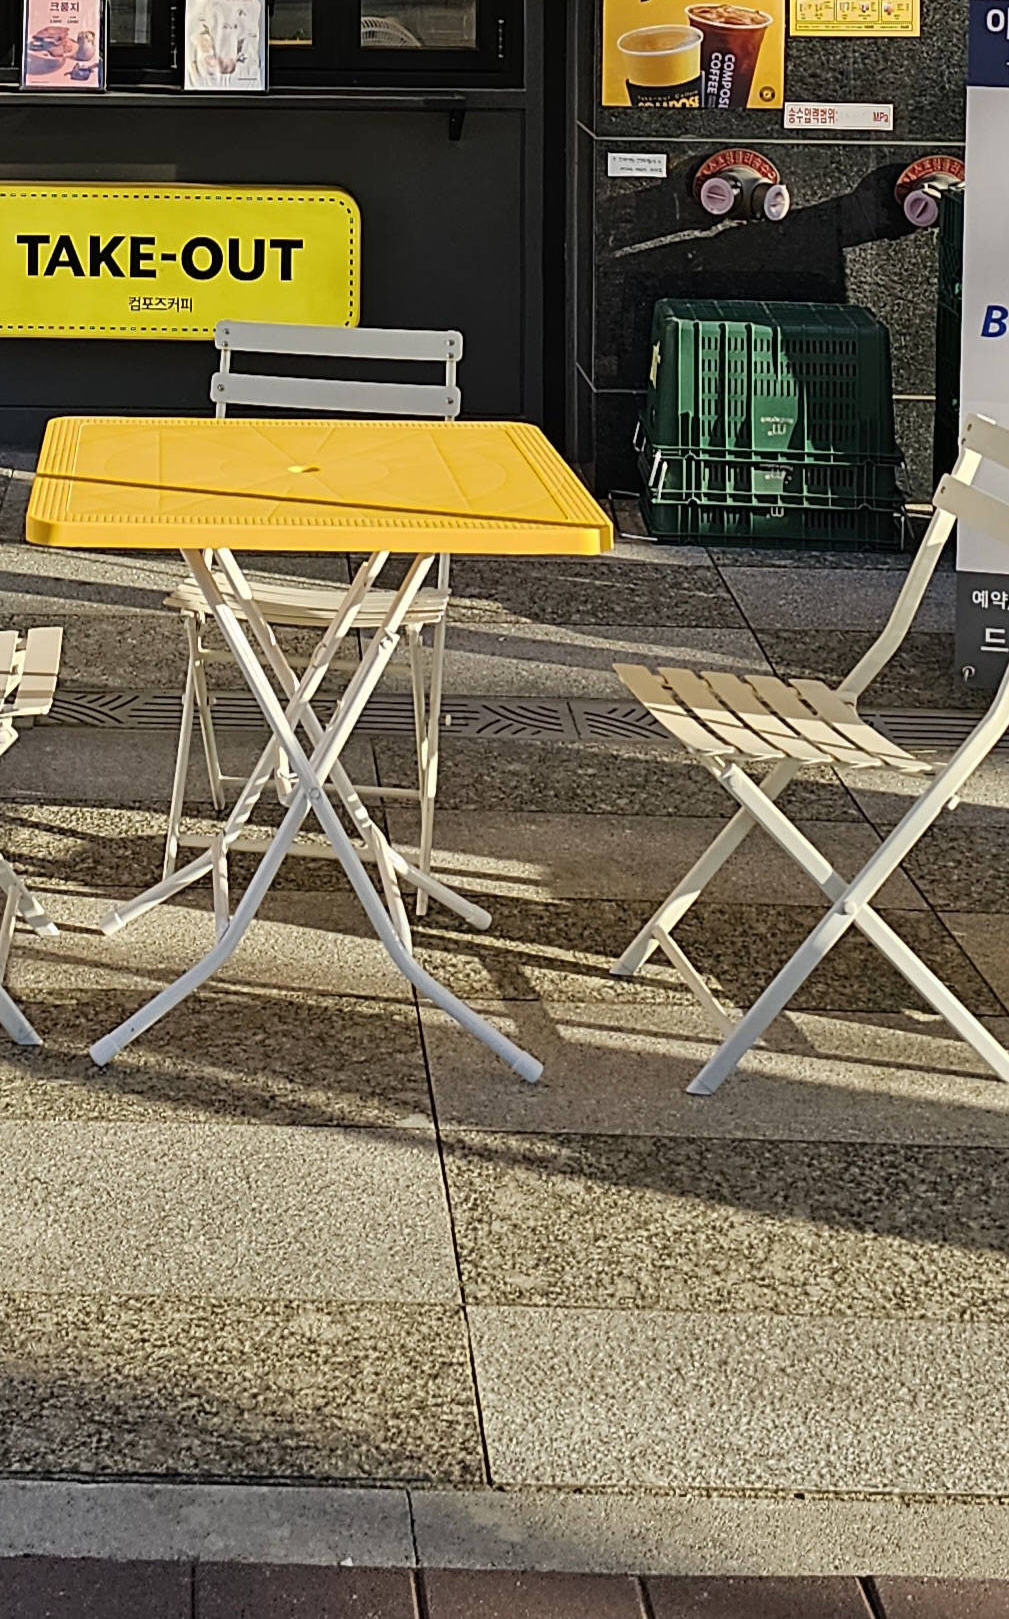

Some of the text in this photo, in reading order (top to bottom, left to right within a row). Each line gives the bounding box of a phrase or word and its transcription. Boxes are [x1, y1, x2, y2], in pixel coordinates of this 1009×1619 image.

[706, 52, 722, 95] COFFEE
[16, 234, 304, 281] TAKE-OUT
[128, 296, 193, 313] 컴포즈커피
